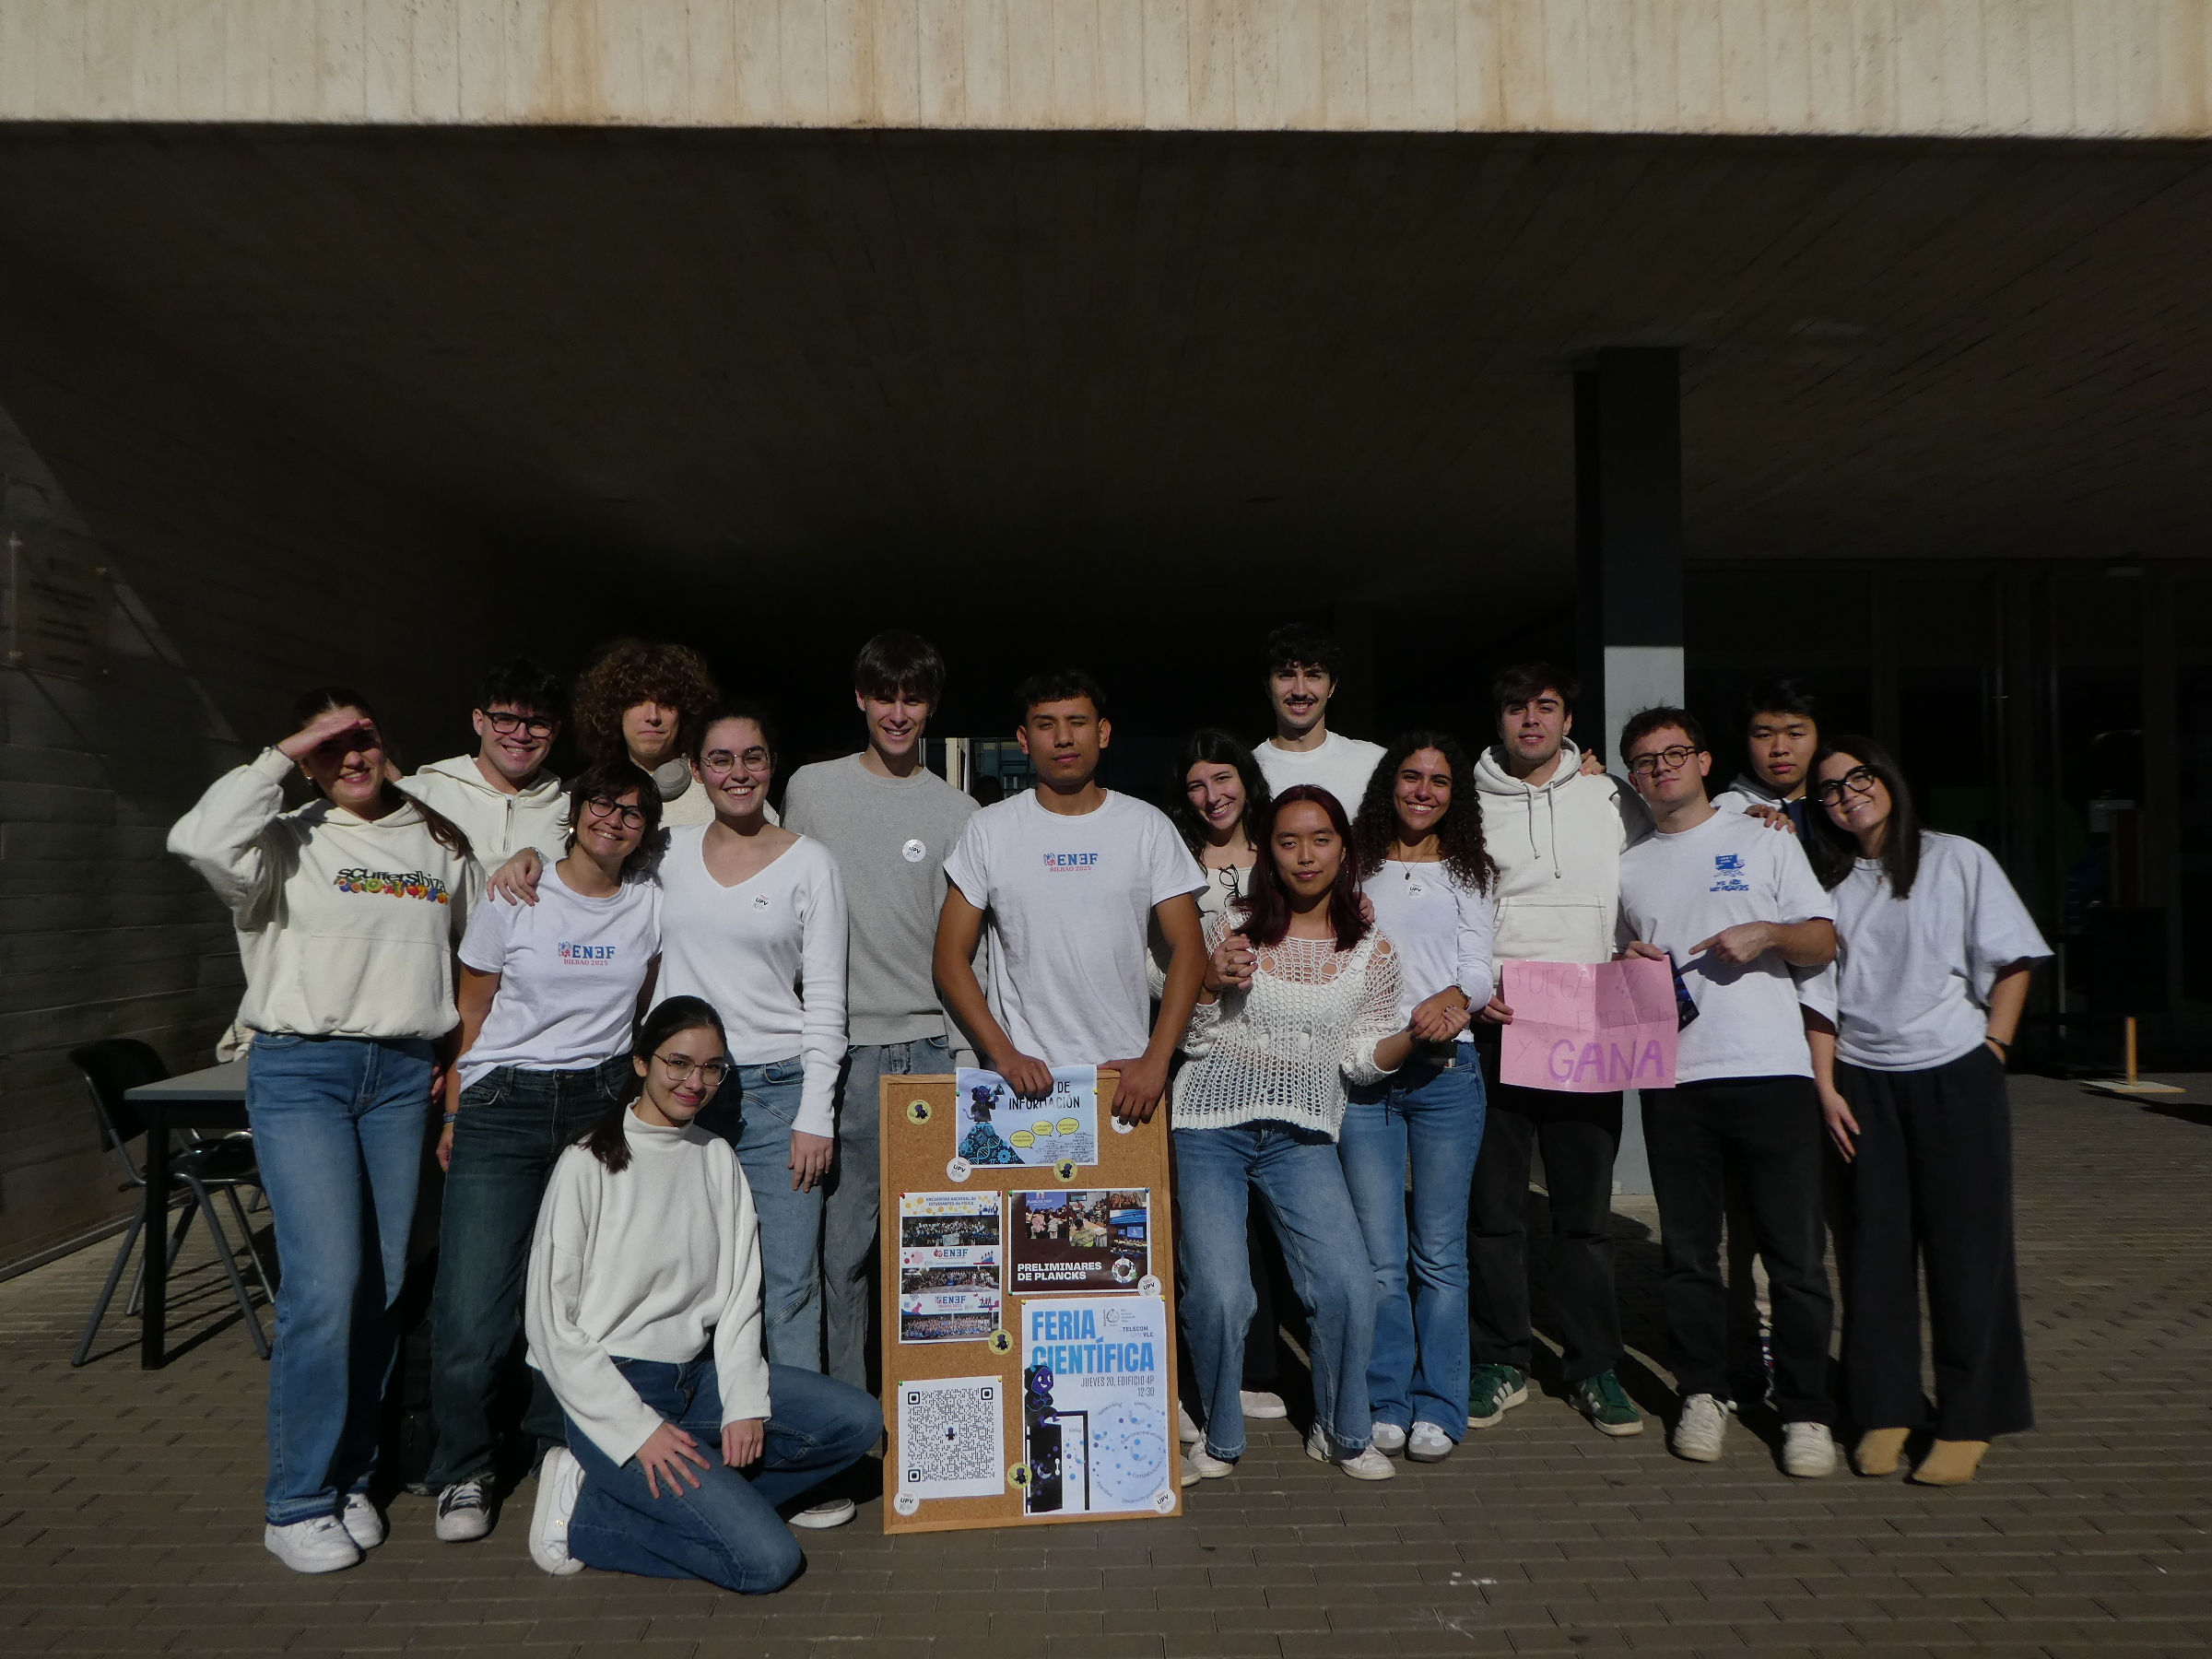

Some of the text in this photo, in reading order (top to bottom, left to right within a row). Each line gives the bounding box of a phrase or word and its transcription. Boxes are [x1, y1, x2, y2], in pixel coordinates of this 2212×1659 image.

[755, 897, 769, 906] UPV
[1507, 967, 1595, 1001] JUEGA
[1547, 1038, 1665, 1084] GANA
[1057, 1081, 1071, 1093] DE
[952, 1163, 967, 1173] UPV
[1017, 1261, 1102, 1272] PRELIMINARES
[1017, 1271, 1087, 1281] DE PLANCKS
[1143, 1282, 1155, 1290] UPV
[1031, 1309, 1097, 1341] FERIA
[1031, 1336, 1155, 1375] CIENTÍFICA
[1080, 1376, 1106, 1387] JUEVES
[1106, 1376, 1116, 1387] 20,
[1117, 1375, 1145, 1386] EDIFICIO
[1137, 1387, 1155, 1397] 12:30
[1098, 1402, 1123, 1416] Networking
[1134, 1401, 1152, 1411] Premios
[1156, 1493, 1170, 1505] UPV
